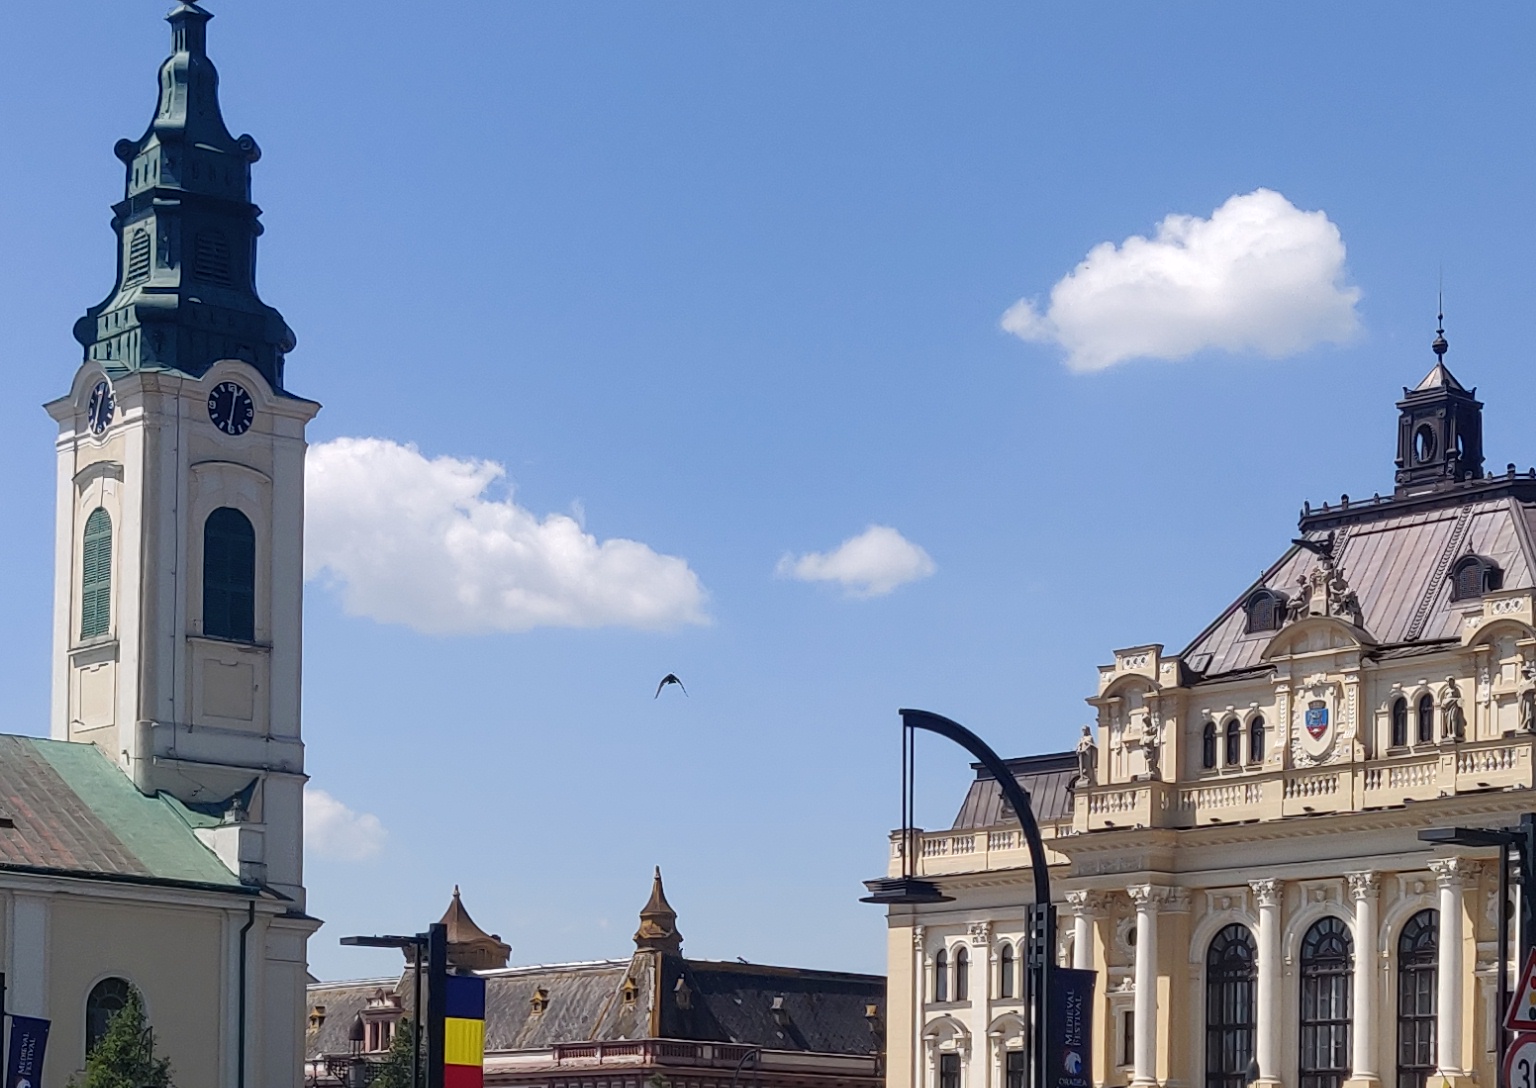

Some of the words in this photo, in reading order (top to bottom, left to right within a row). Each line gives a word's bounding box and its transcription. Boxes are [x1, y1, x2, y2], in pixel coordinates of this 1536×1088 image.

[208, 400, 217, 409] 9
[246, 408, 253, 417] 3
[1065, 988, 1074, 1046] MEDIEVAL
[1073, 995, 1082, 1046] FESTIVAL
[18, 1032, 30, 1074] MEDIEVAL
[24, 1038, 36, 1076] FESTIVAL
